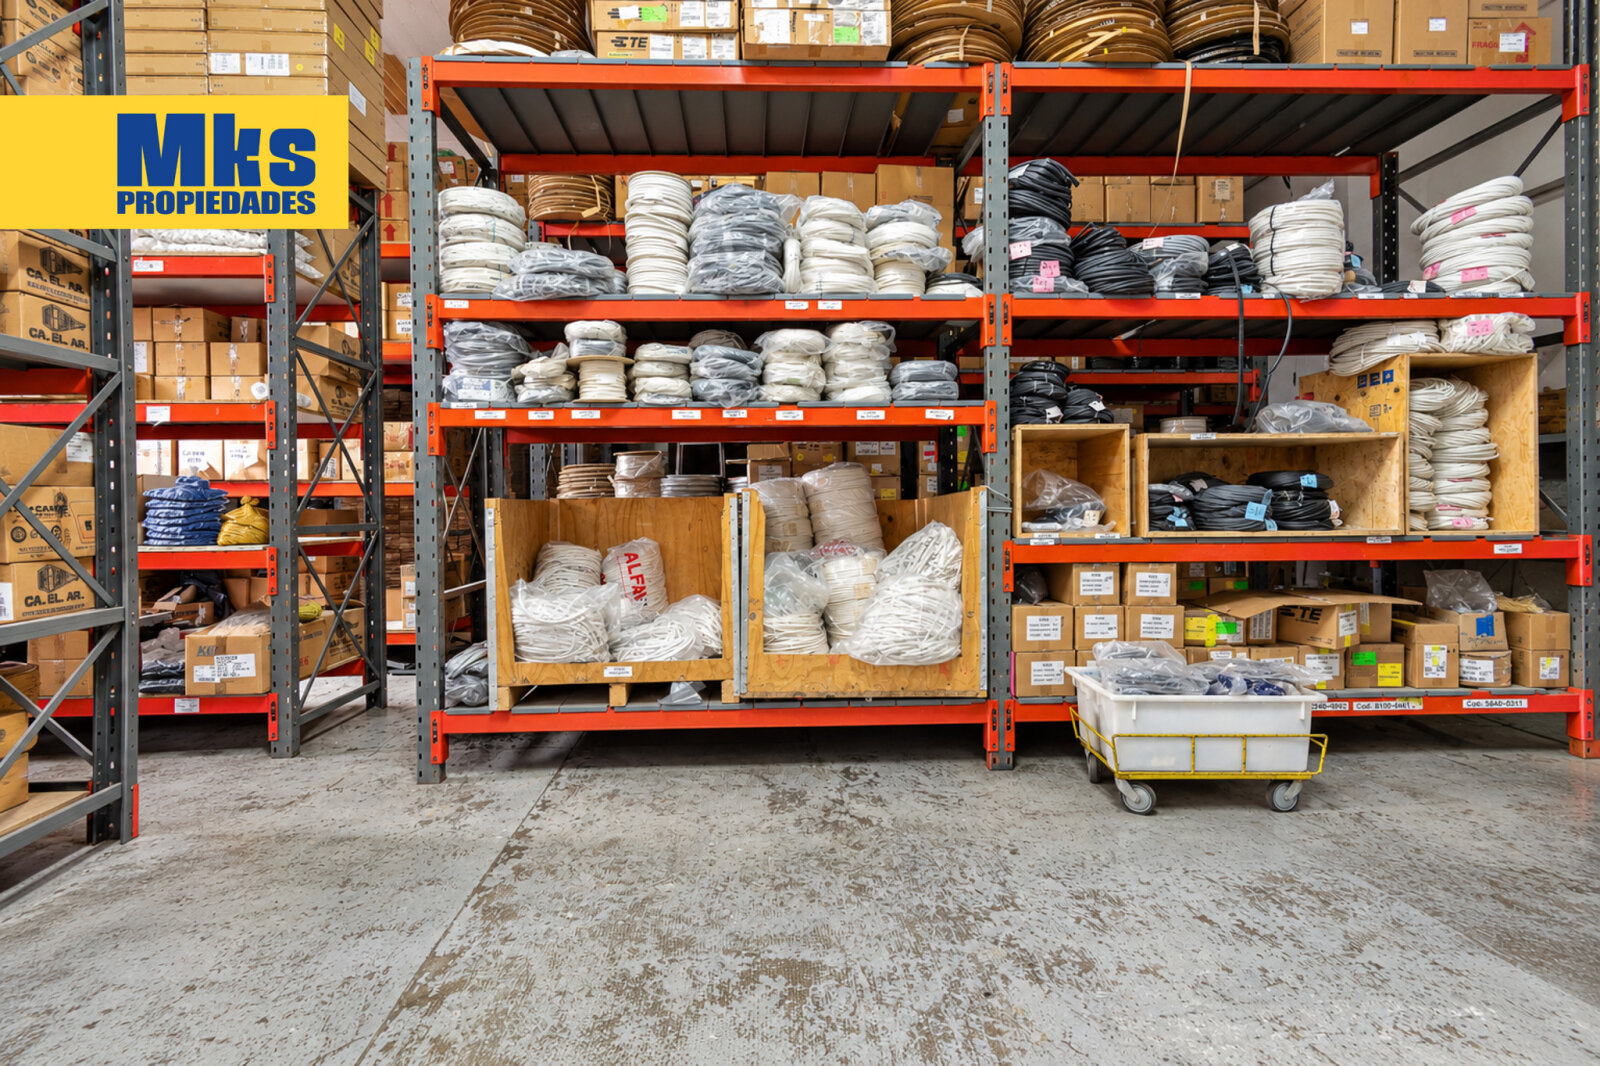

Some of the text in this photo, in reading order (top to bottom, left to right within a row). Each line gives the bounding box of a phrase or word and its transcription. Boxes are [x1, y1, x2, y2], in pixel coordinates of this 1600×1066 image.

[26, 267, 47, 282] CA.
[49, 275, 66, 288] EL.
[28, 327, 89, 351] CA. EL. AR.
[24, 590, 85, 607] CA. EL. AR.
